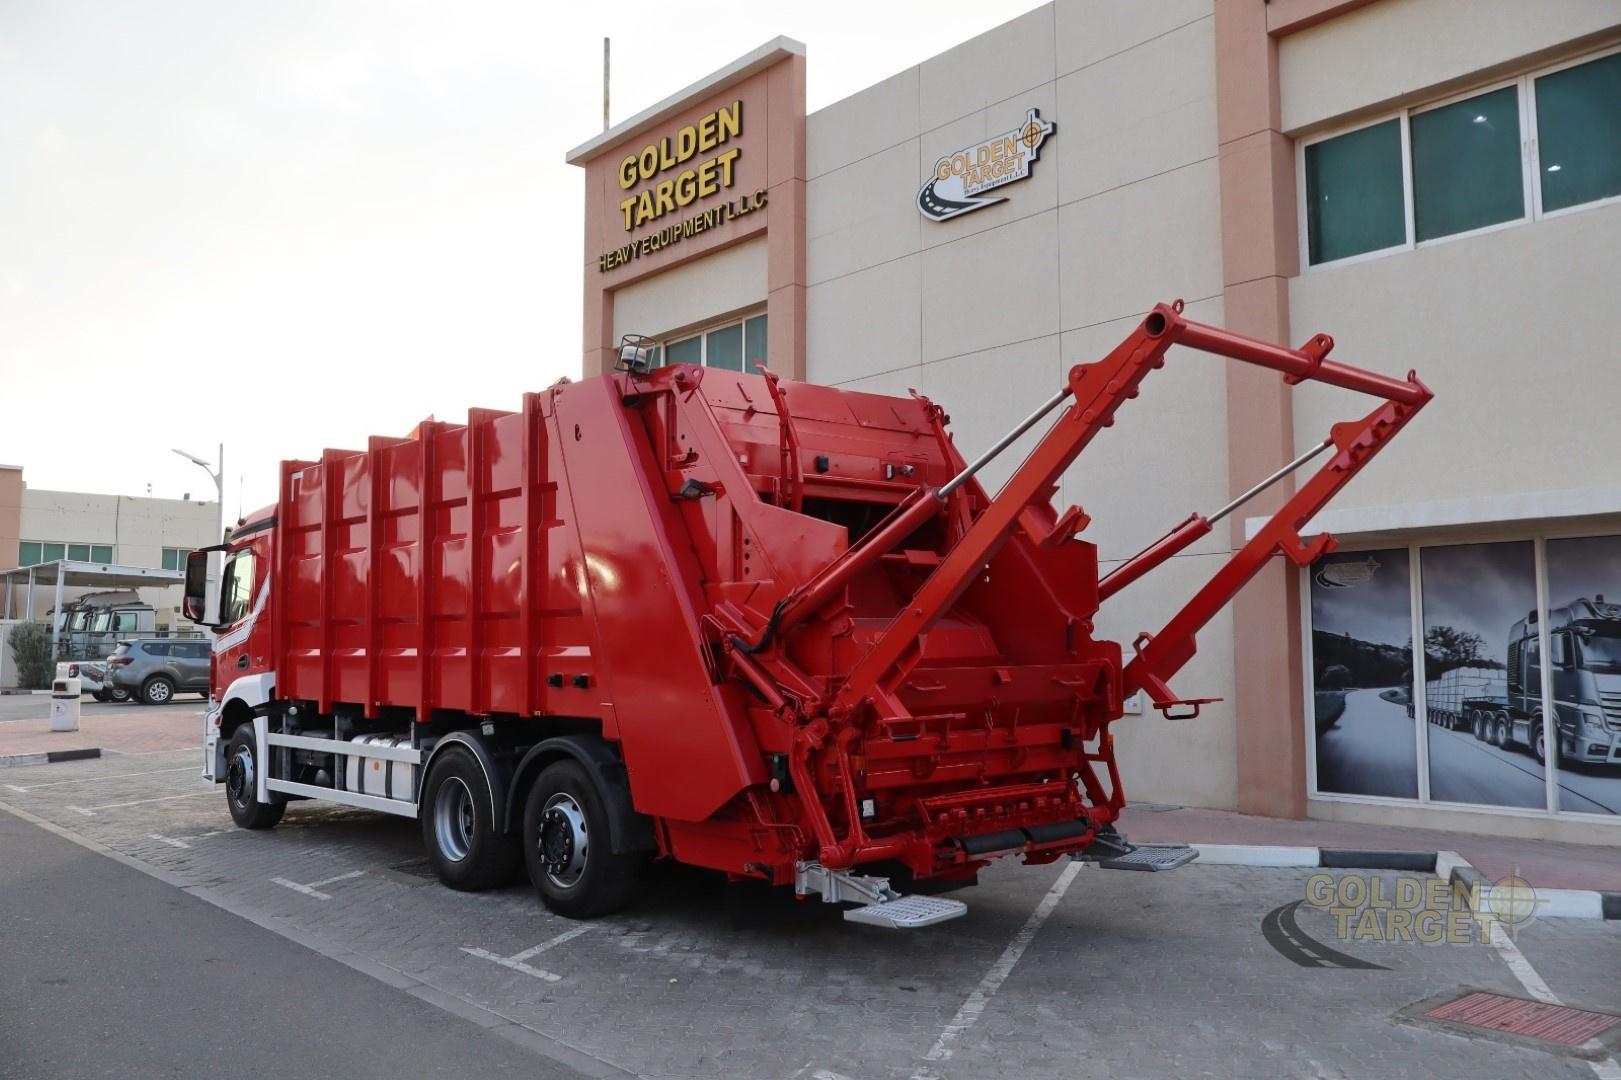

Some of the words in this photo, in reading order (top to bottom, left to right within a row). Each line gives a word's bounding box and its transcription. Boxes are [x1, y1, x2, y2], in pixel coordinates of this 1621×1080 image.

[618, 100, 742, 190] GOLDEN
[937, 135, 1018, 180] GOLDEN
[960, 152, 1025, 189] TARGET
[599, 240, 641, 272] HEAVY
[642, 204, 724, 255] EQUIPMENT
[726, 188, 768, 221] L.L.C
[619, 148, 741, 231] TARGET
